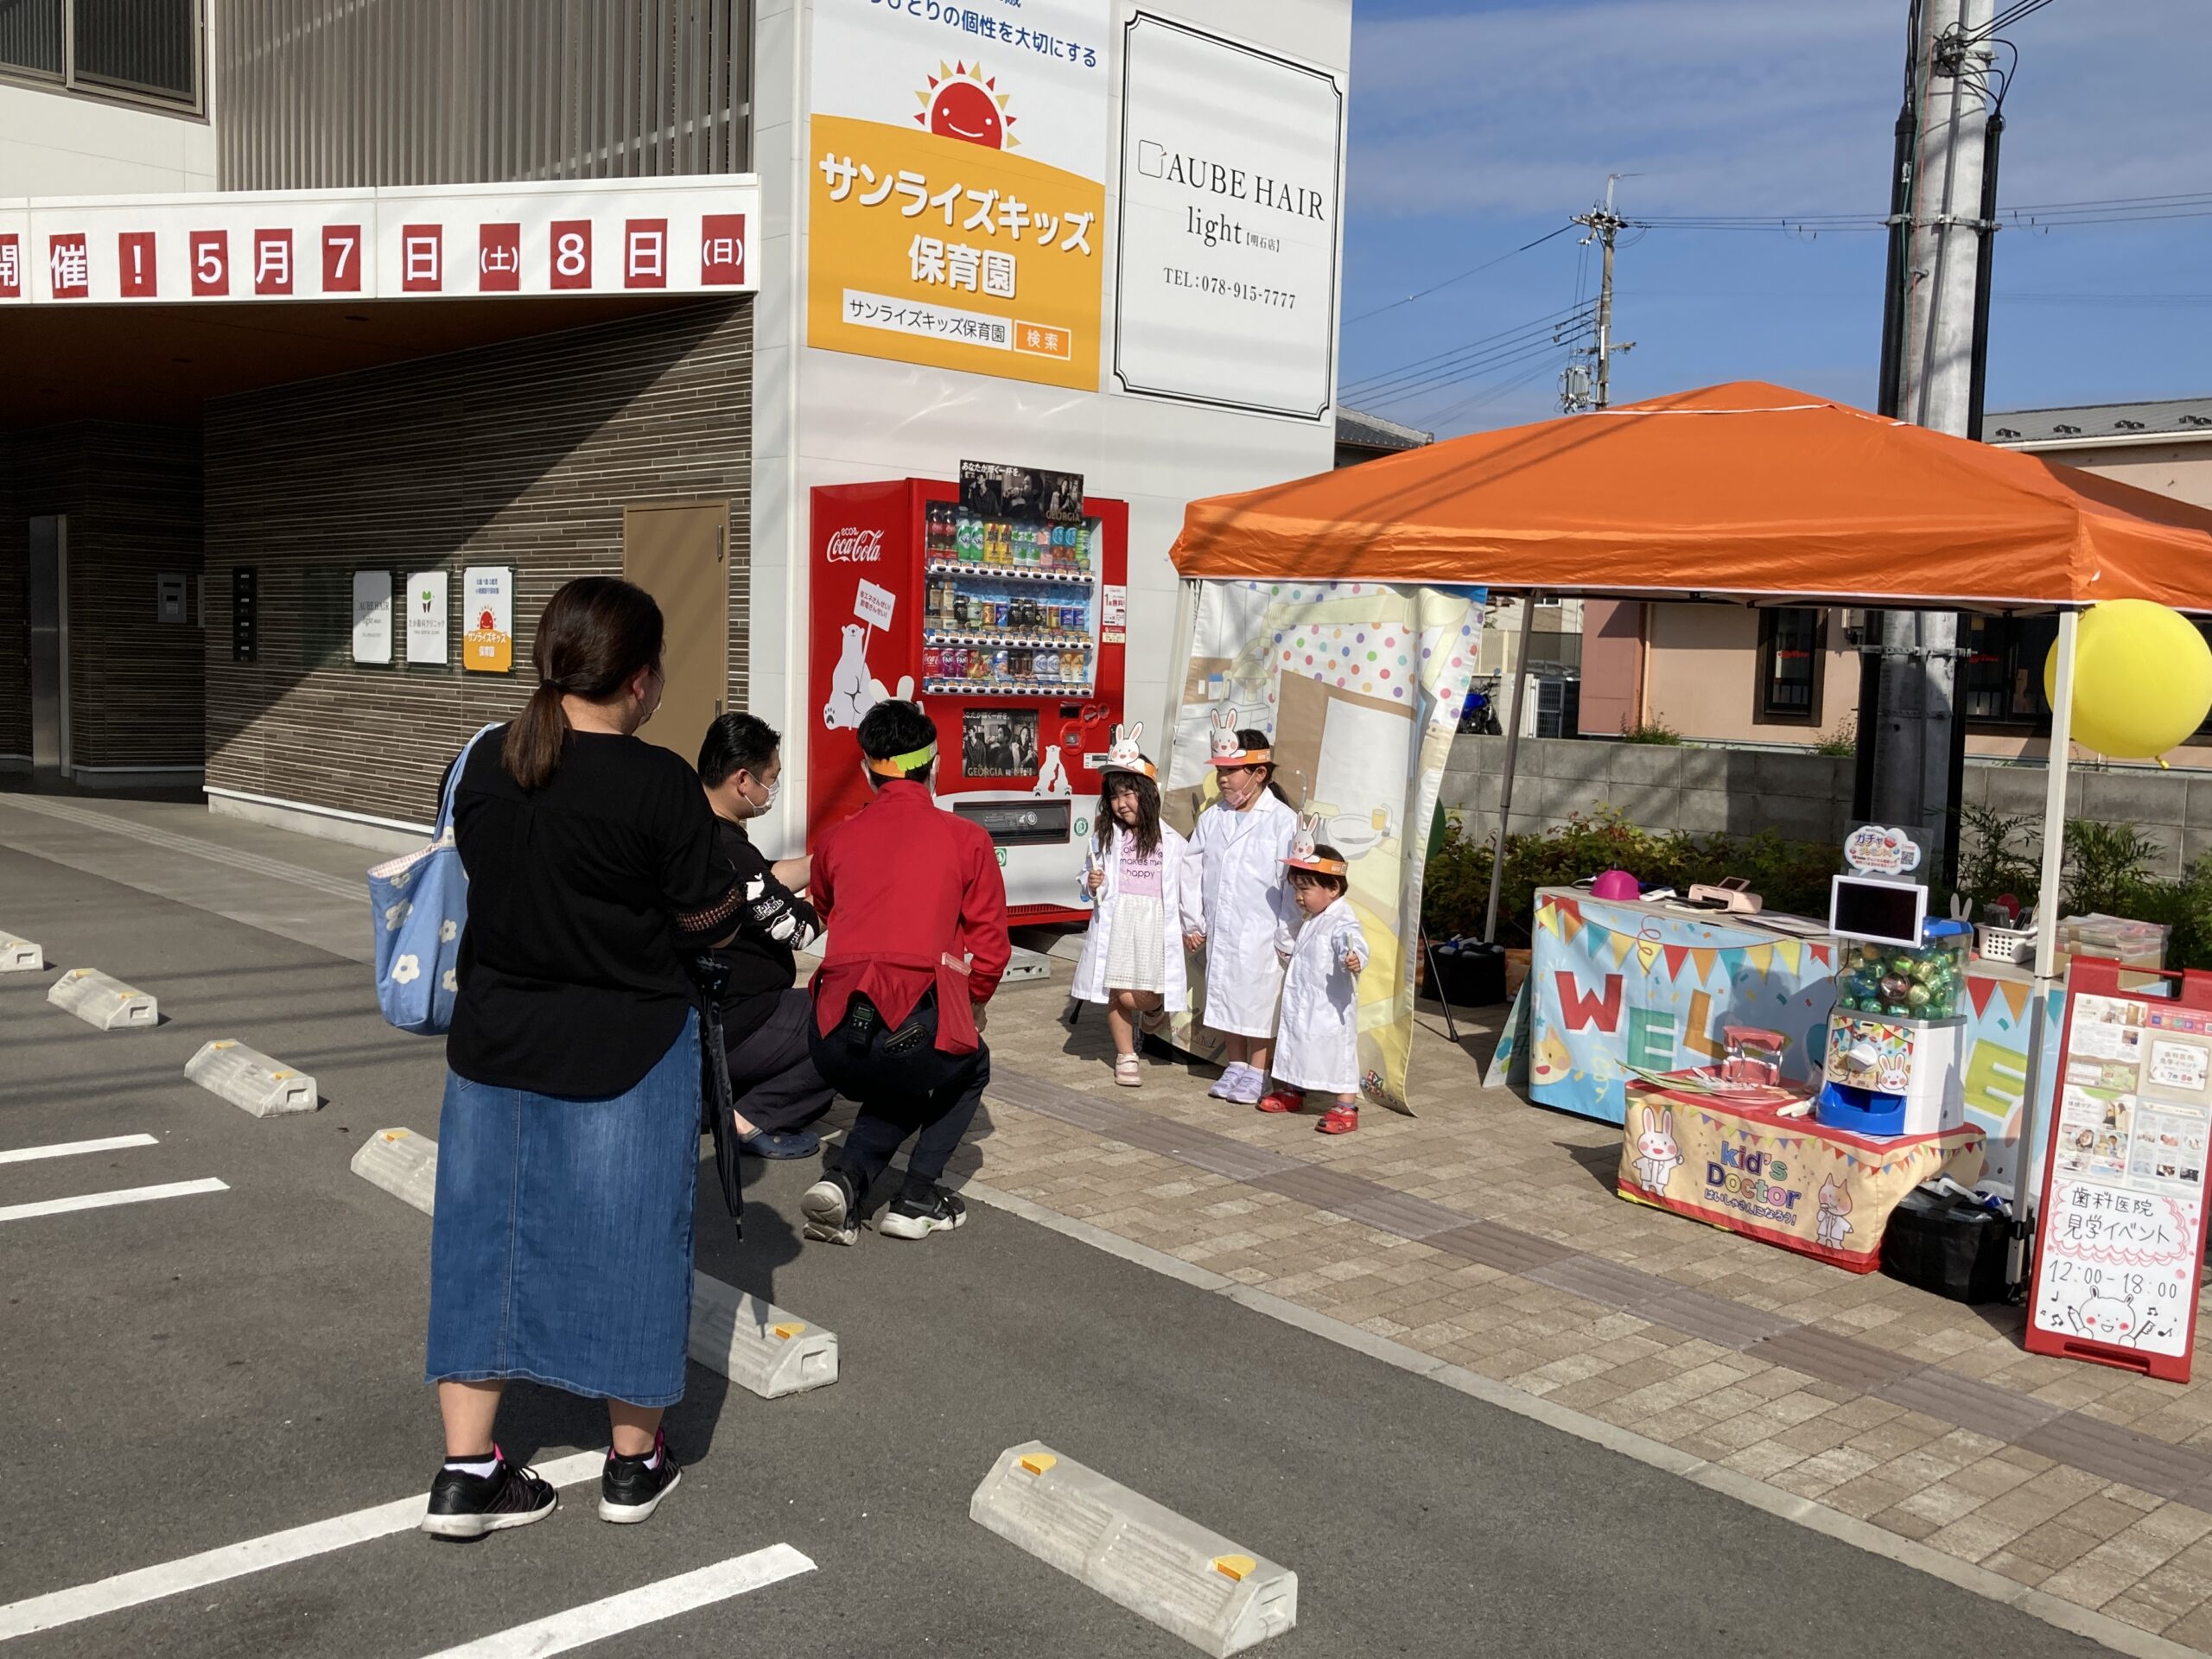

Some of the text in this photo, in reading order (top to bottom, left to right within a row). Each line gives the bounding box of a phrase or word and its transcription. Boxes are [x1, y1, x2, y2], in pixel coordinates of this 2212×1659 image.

[818, 152, 1096, 255] サンライズキッズ
[1166, 153, 1325, 221] AUBE HAIR
[1186, 206, 1242, 248] light
[907, 233, 1017, 299] 保育園
[1163, 267, 1296, 310] TEL:078-915-7777
[849, 298, 1006, 344] サンライズキッズ保育園
[1027, 328, 1059, 353] 検索
[826, 529, 886, 563] Coca-Cola
[967, 766, 1003, 777] GEORGIA
[1126, 868, 1156, 880] happy
[1719, 1140, 1788, 1181] kid's
[1706, 1160, 1802, 1210] Doctor
[2072, 1186, 2154, 1217] 歯科医院
[1703, 1187, 1797, 1226] はいしゃさんになろう!
[2063, 1213, 2171, 1244] 見学イベント
